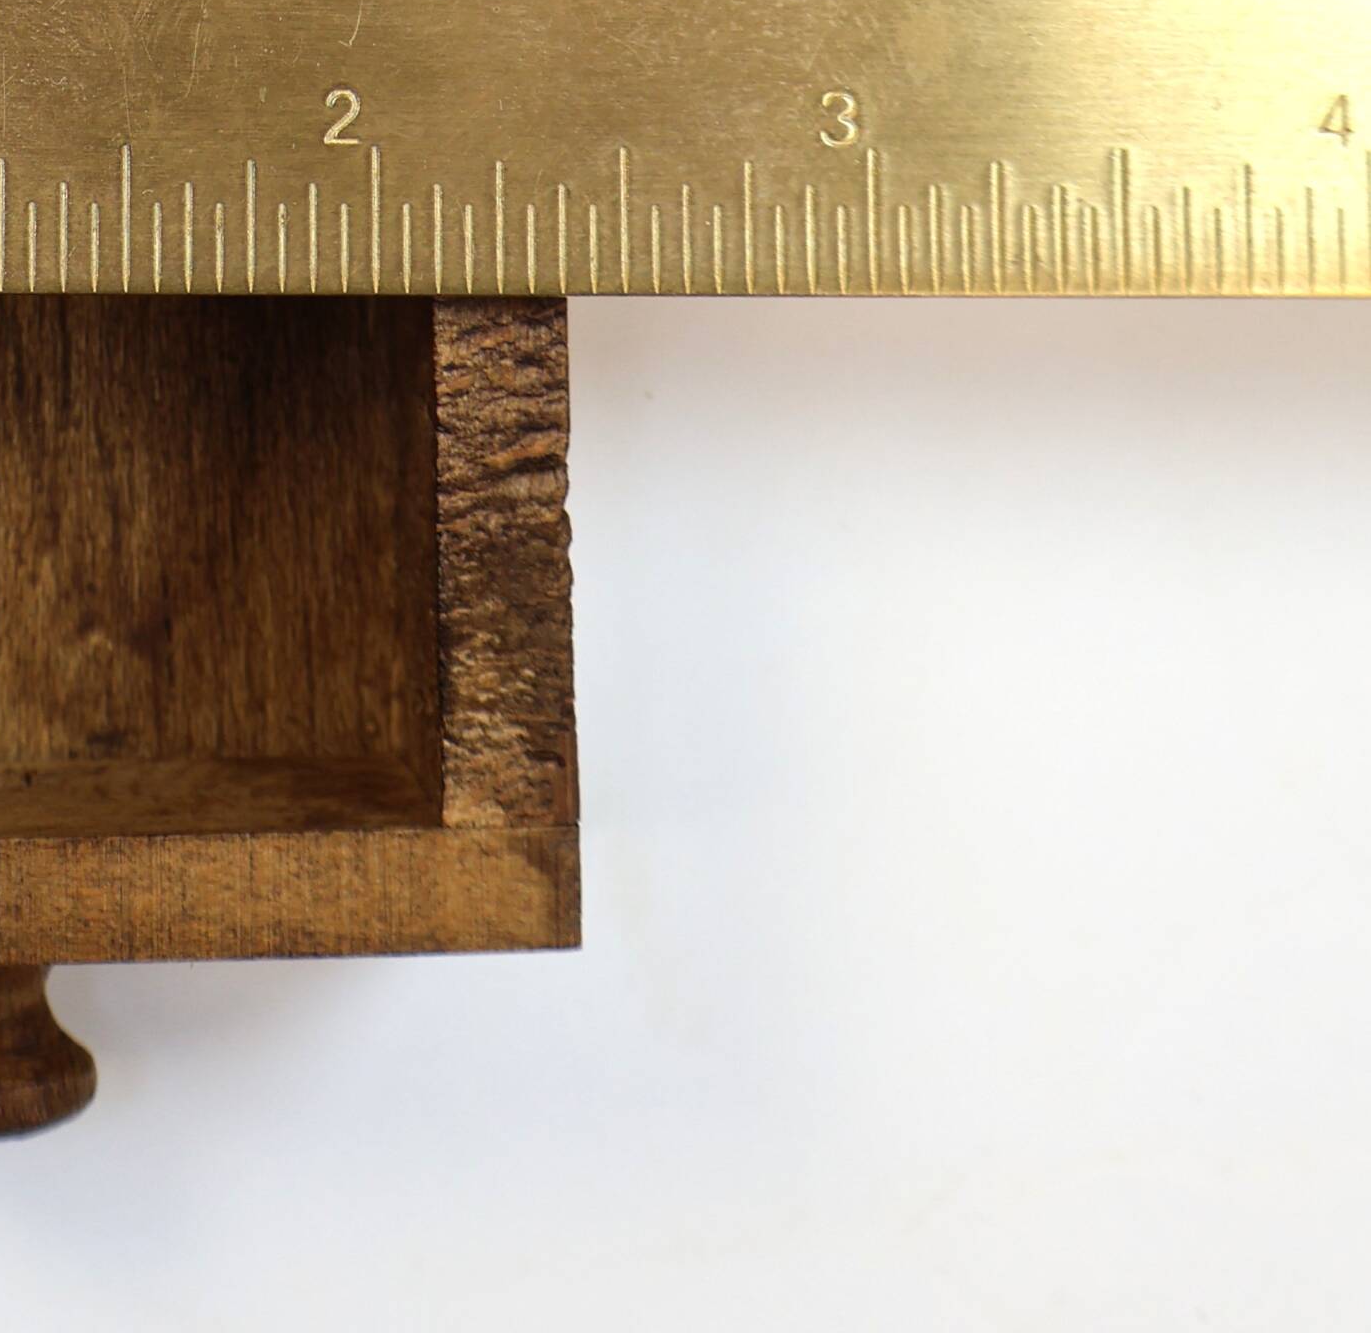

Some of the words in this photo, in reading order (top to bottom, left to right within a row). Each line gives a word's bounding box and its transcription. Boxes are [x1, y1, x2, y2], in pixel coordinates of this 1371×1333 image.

[322, 88, 361, 145] 2
[819, 91, 859, 148] 3
[1318, 94, 1354, 146] 4
